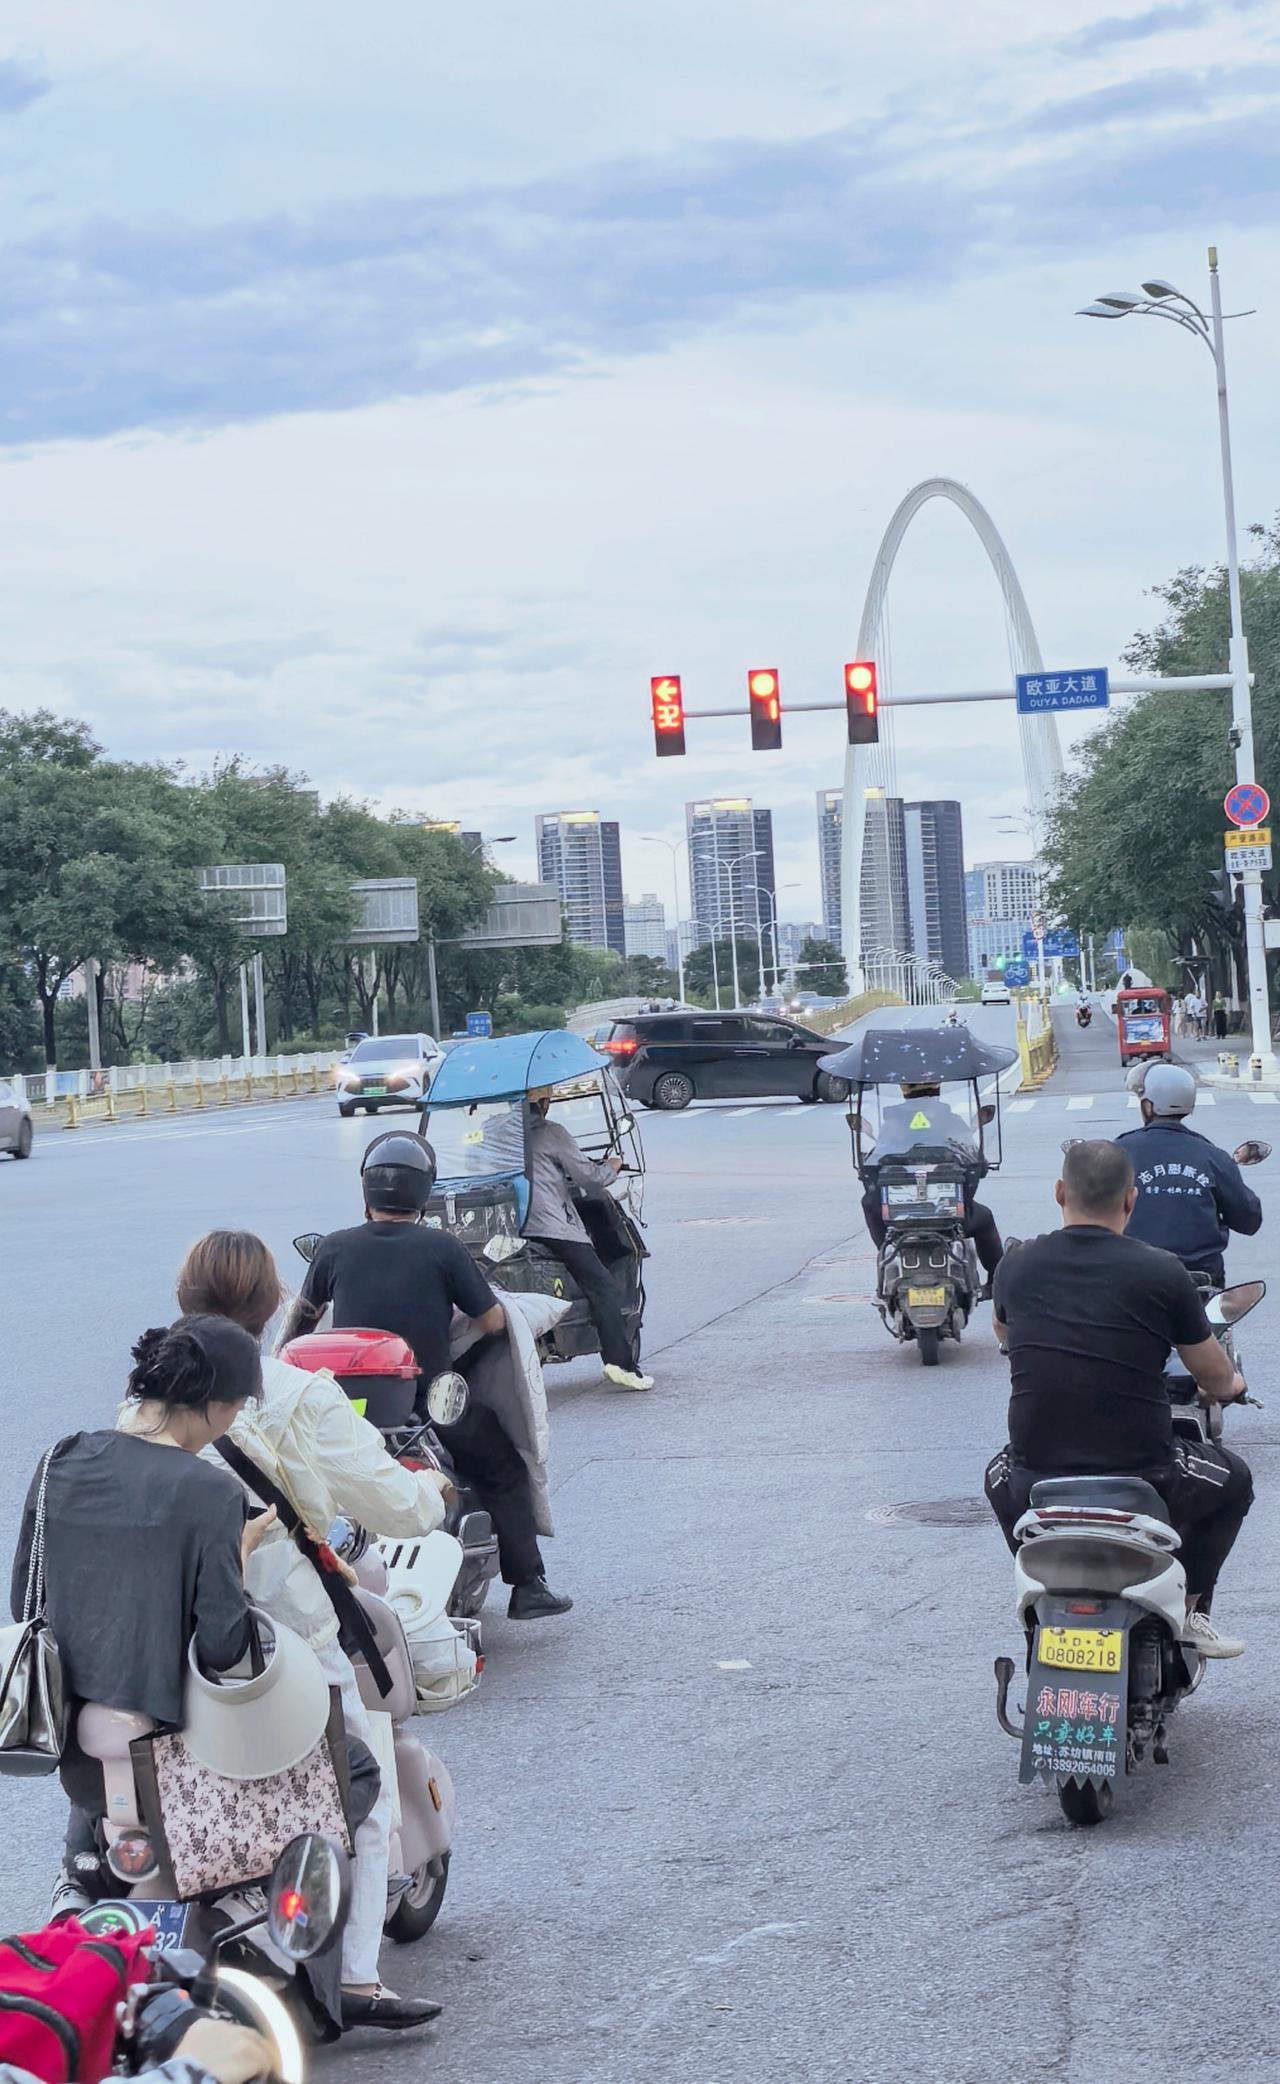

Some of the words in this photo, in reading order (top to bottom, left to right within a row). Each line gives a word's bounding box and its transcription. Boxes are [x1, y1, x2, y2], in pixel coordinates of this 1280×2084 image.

[1026, 675, 1098, 696] 欧亚大道
[1030, 698, 1058, 708] OUYA
[1062, 694, 1097, 704] DADAO
[657, 704, 681, 729] 32
[1046, 1646, 1117, 1667] 0808218
[1036, 1686, 1120, 1723] 永刚车行
[1033, 1720, 1118, 1747] 只卖好车
